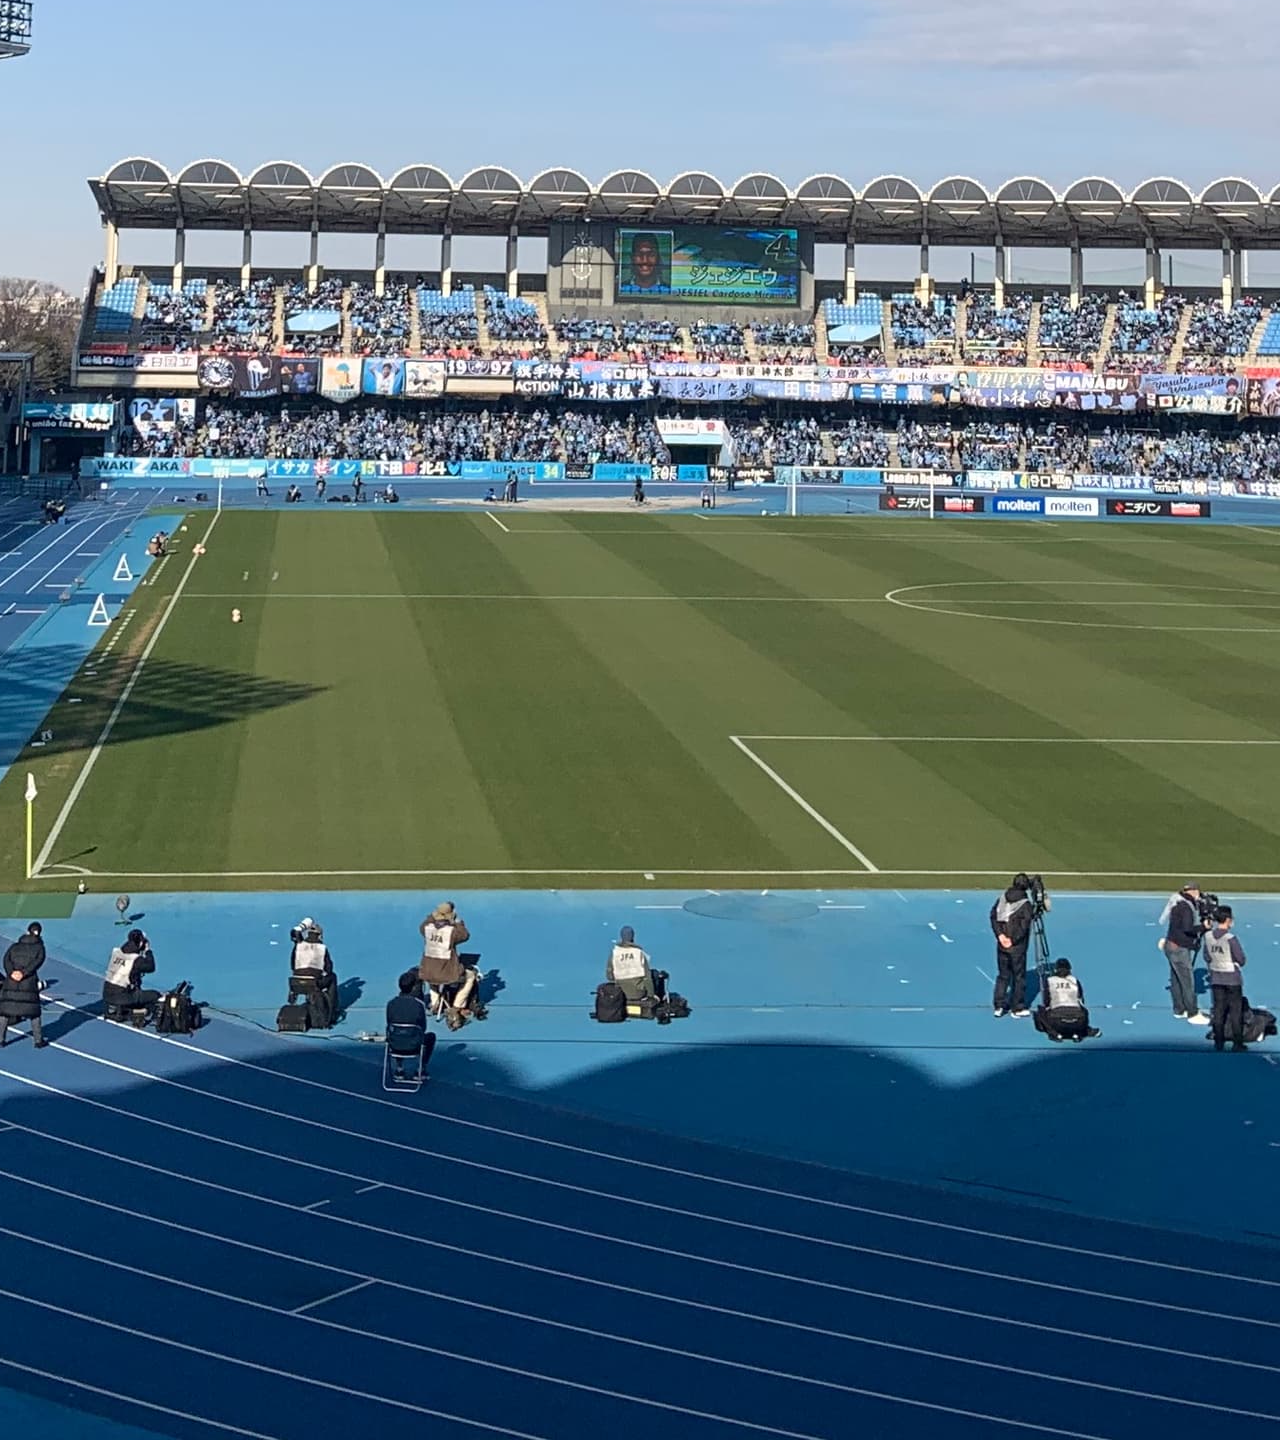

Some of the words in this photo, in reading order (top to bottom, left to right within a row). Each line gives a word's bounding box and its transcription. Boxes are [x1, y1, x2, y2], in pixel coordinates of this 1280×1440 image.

[764, 232, 791, 260] 4
[689, 266, 779, 286] ジェジエウ
[677, 288, 709, 298] JESIEL
[712, 289, 751, 299] Cardoso
[447, 360, 467, 375] 19
[490, 360, 513, 376] 97
[515, 379, 560, 393] ACTION
[1056, 375, 1129, 391] MANABU
[97, 458, 180, 474] WAKIZAKA
[997, 499, 1041, 511] molten
[1050, 500, 1093, 513] molten
[429, 933, 444, 944] JFA
[620, 953, 635, 962] JFA
